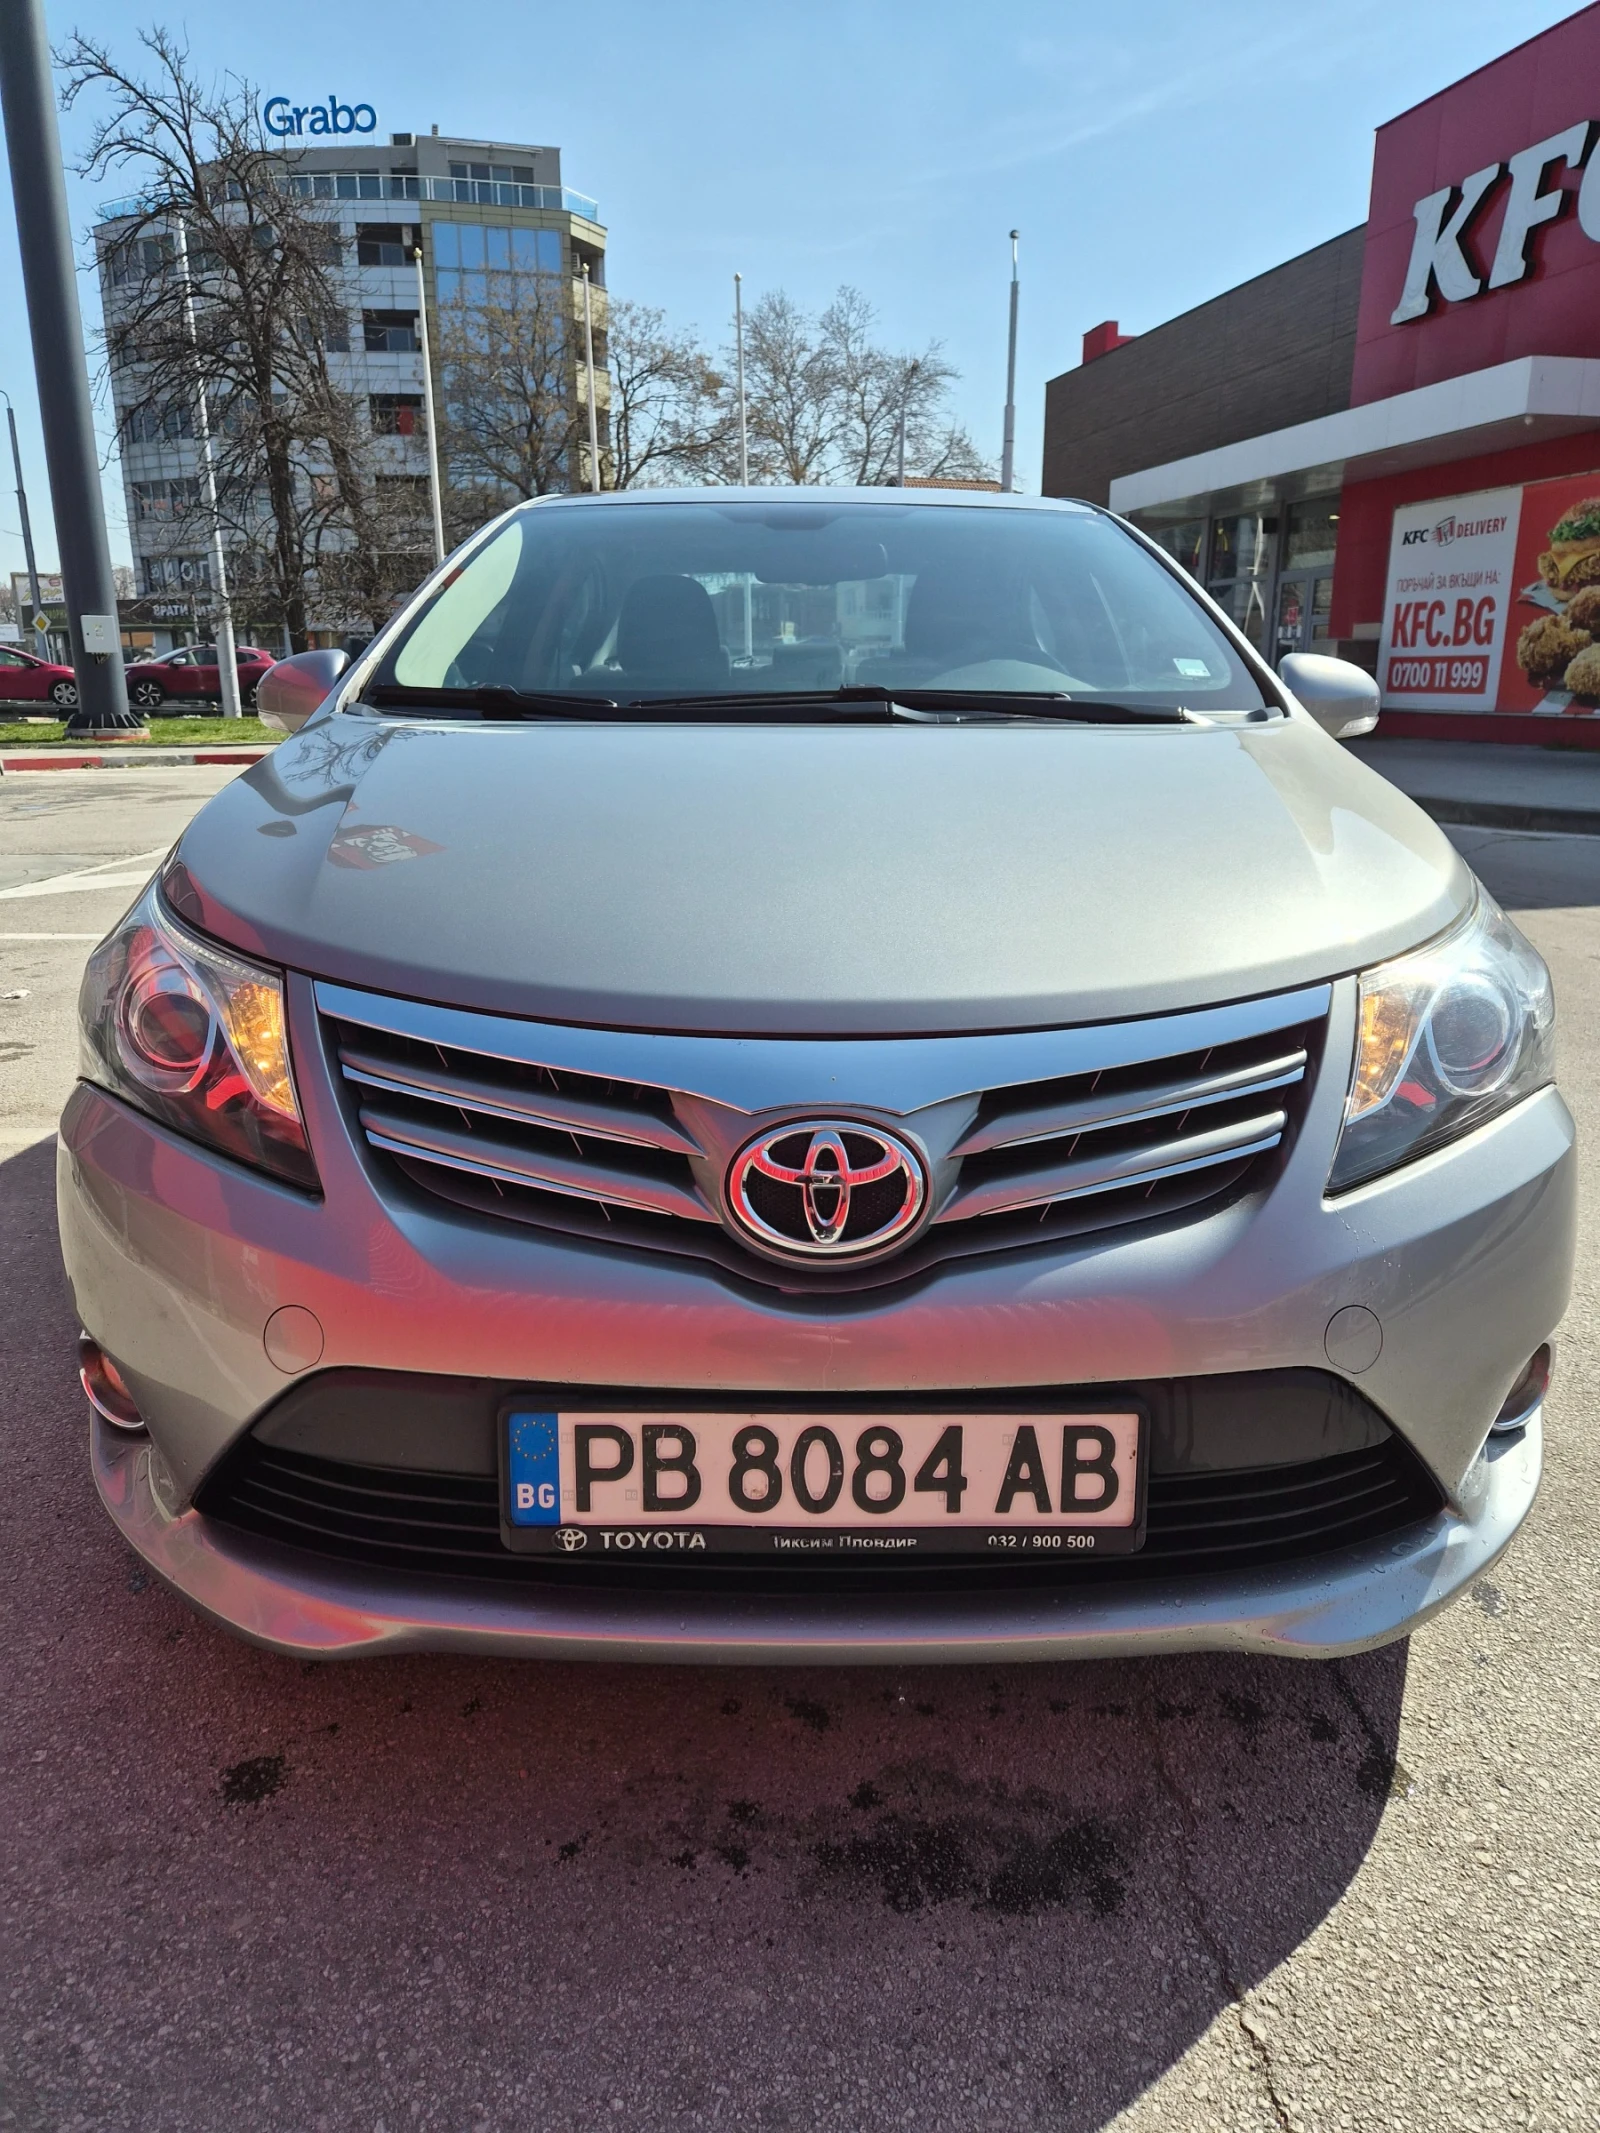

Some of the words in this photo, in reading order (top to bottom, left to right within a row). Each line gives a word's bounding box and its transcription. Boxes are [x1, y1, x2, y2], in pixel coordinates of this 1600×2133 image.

[264, 95, 377, 136] Grabo
[1402, 529, 1429, 546] KFC
[1456, 516, 1507, 538] DELIVERY
[1396, 572, 1434, 593] ПОРЪЧАЙ
[1436, 575, 1447, 590] ЗА
[1449, 572, 1483, 589] ВКЪЩИ
[1484, 571, 1501, 586] НА:
[1391, 596, 1496, 648] KFC.BG
[1391, 664, 1430, 687] 0700
[1434, 663, 1447, 686] 11
[1450, 662, 1483, 687] 999
[574, 1424, 702, 1512] PB
[728, 1425, 967, 1514] 8084
[994, 1425, 1120, 1513] AB
[516, 1483, 556, 1509] BG
[600, 1531, 707, 1550] TOYOTA
[987, 1535, 1017, 1548] 032
[1032, 1535, 1061, 1548] 900
[1066, 1535, 1095, 1548] 500
